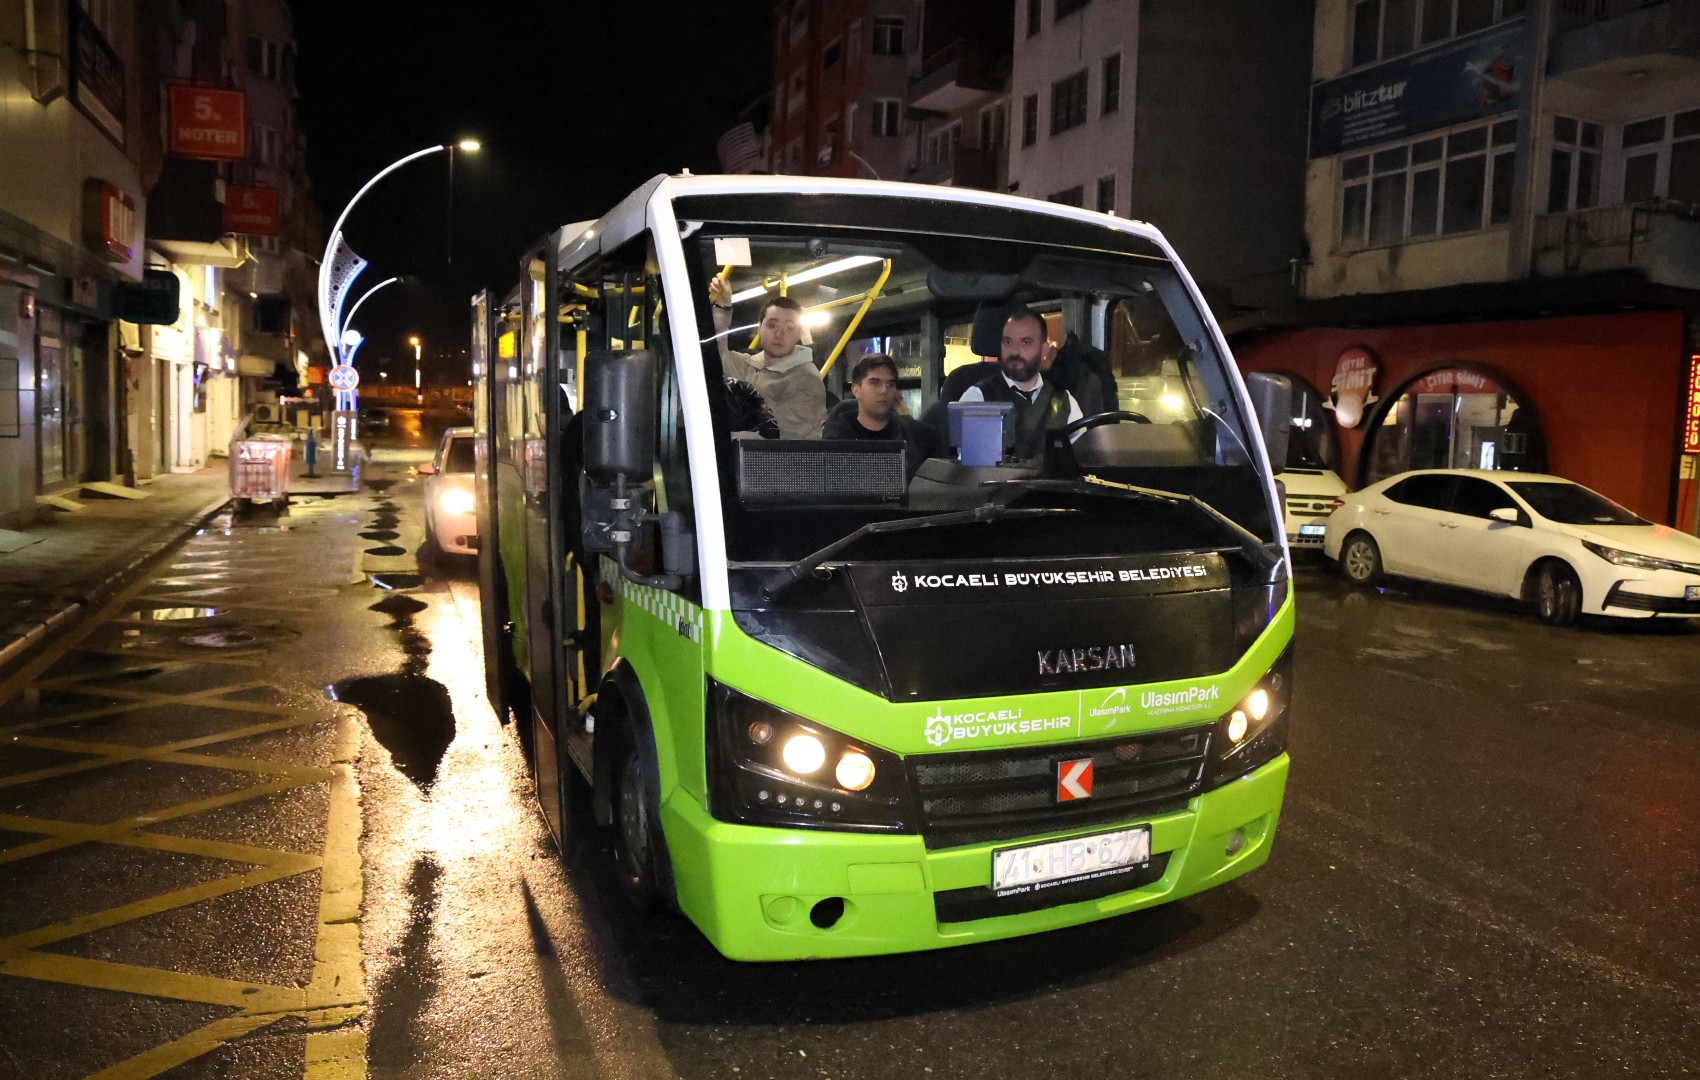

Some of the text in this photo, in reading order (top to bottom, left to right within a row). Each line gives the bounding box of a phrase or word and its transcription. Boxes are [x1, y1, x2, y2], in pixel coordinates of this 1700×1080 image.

[194, 96, 222, 121] 5.
[1343, 81, 1407, 112] blitztur
[178, 127, 237, 144] NOTER
[1037, 643, 1136, 675] KARSAN
[1005, 831, 1143, 880] 41 HB 627
